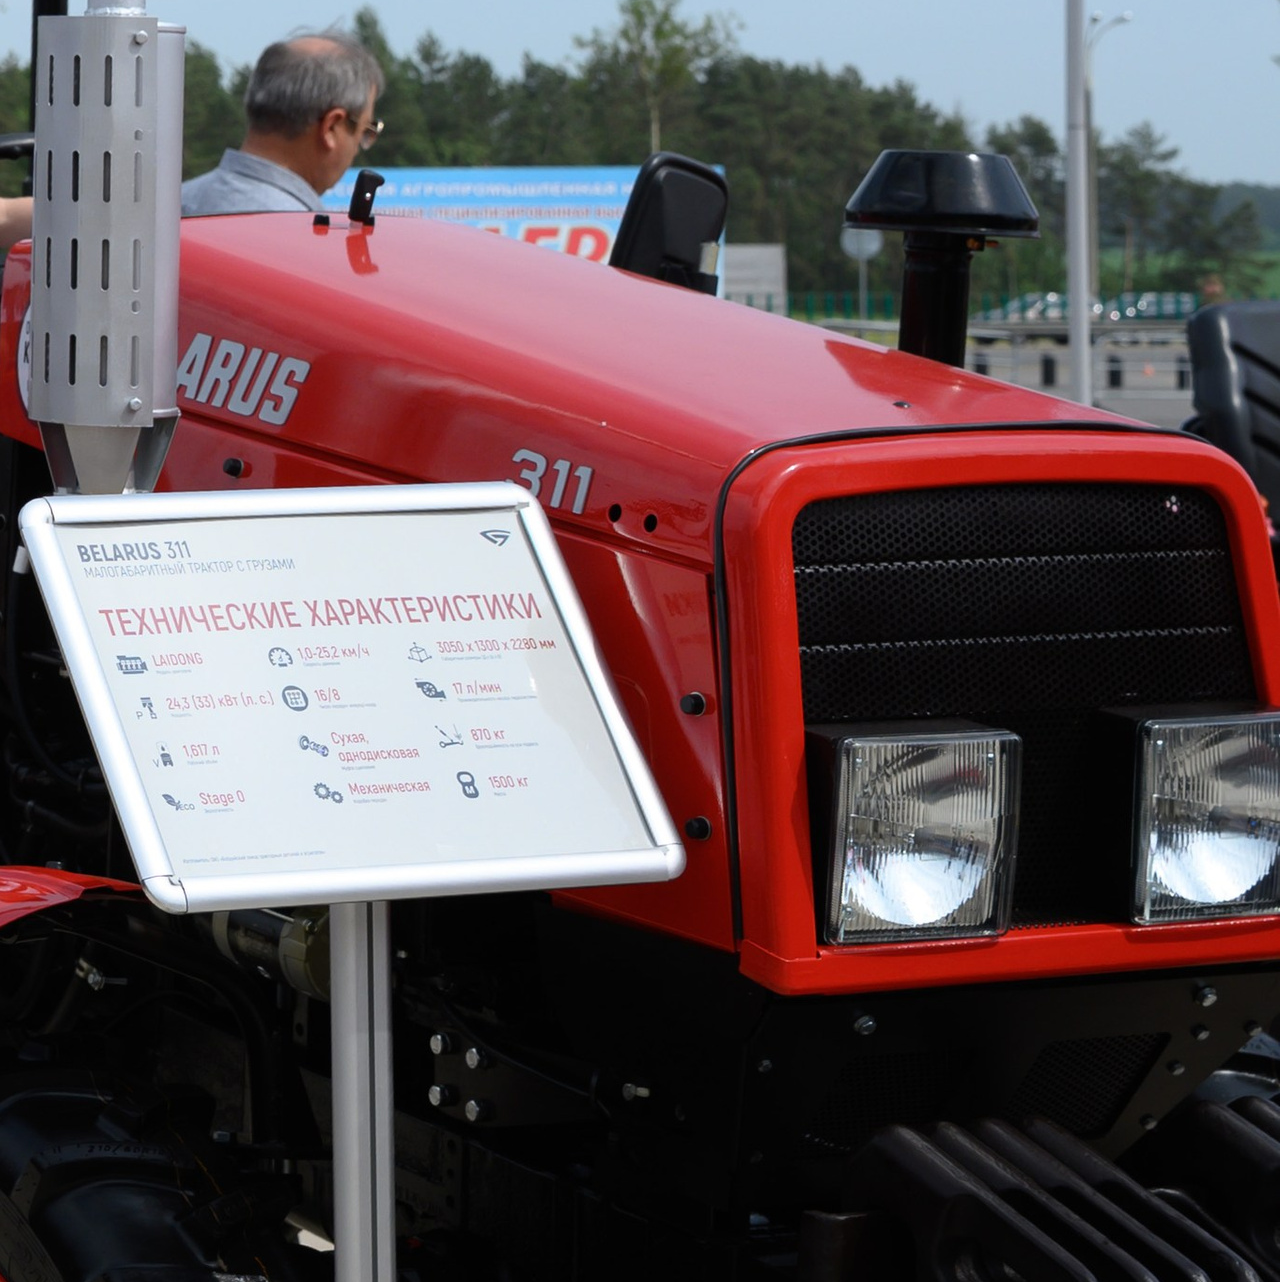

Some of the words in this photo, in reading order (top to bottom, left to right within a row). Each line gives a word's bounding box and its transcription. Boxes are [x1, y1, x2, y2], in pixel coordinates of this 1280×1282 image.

[176, 332, 311, 426] ARUS
[507, 448, 593, 515] 311
[77, 541, 162, 563] BELARUS
[164, 540, 192, 559] 311
[84, 561, 187, 579] МАЛОГАБАРИТНЫЙ
[190, 561, 234, 574] ТРАКТОР
[235, 560, 245, 573] С
[246, 558, 297, 572] ГРУЗАМИ
[98, 600, 302, 637] ТЕХНИЧЕСКИЕ
[303, 592, 543, 628] ХАРАКТЕРИСТИКИ
[297, 645, 339, 660] 1,0-25,2
[340, 643, 371, 659] км/ч
[436, 640, 465, 654] 3050
[474, 639, 500, 652] 1300
[510, 638, 538, 651] 2280
[539, 639, 557, 650] мм
[151, 652, 204, 668] LAIDONG
[314, 687, 341, 703] 16/8
[452, 683, 463, 695] 17
[466, 680, 502, 695] л/мин
[165, 696, 191, 711] 24,3
[218, 694, 239, 708] кВт
[330, 731, 370, 747] Сухая,
[470, 728, 492, 742] 870
[493, 730, 506, 741] кг
[182, 743, 209, 759] 1,617
[212, 745, 221, 757] л
[338, 748, 420, 764] однодисковая
[348, 781, 432, 796] Механическая
[488, 775, 515, 789] 1500
[517, 776, 529, 788] кг
[199, 791, 235, 807] Stage
[236, 789, 246, 803] 0
